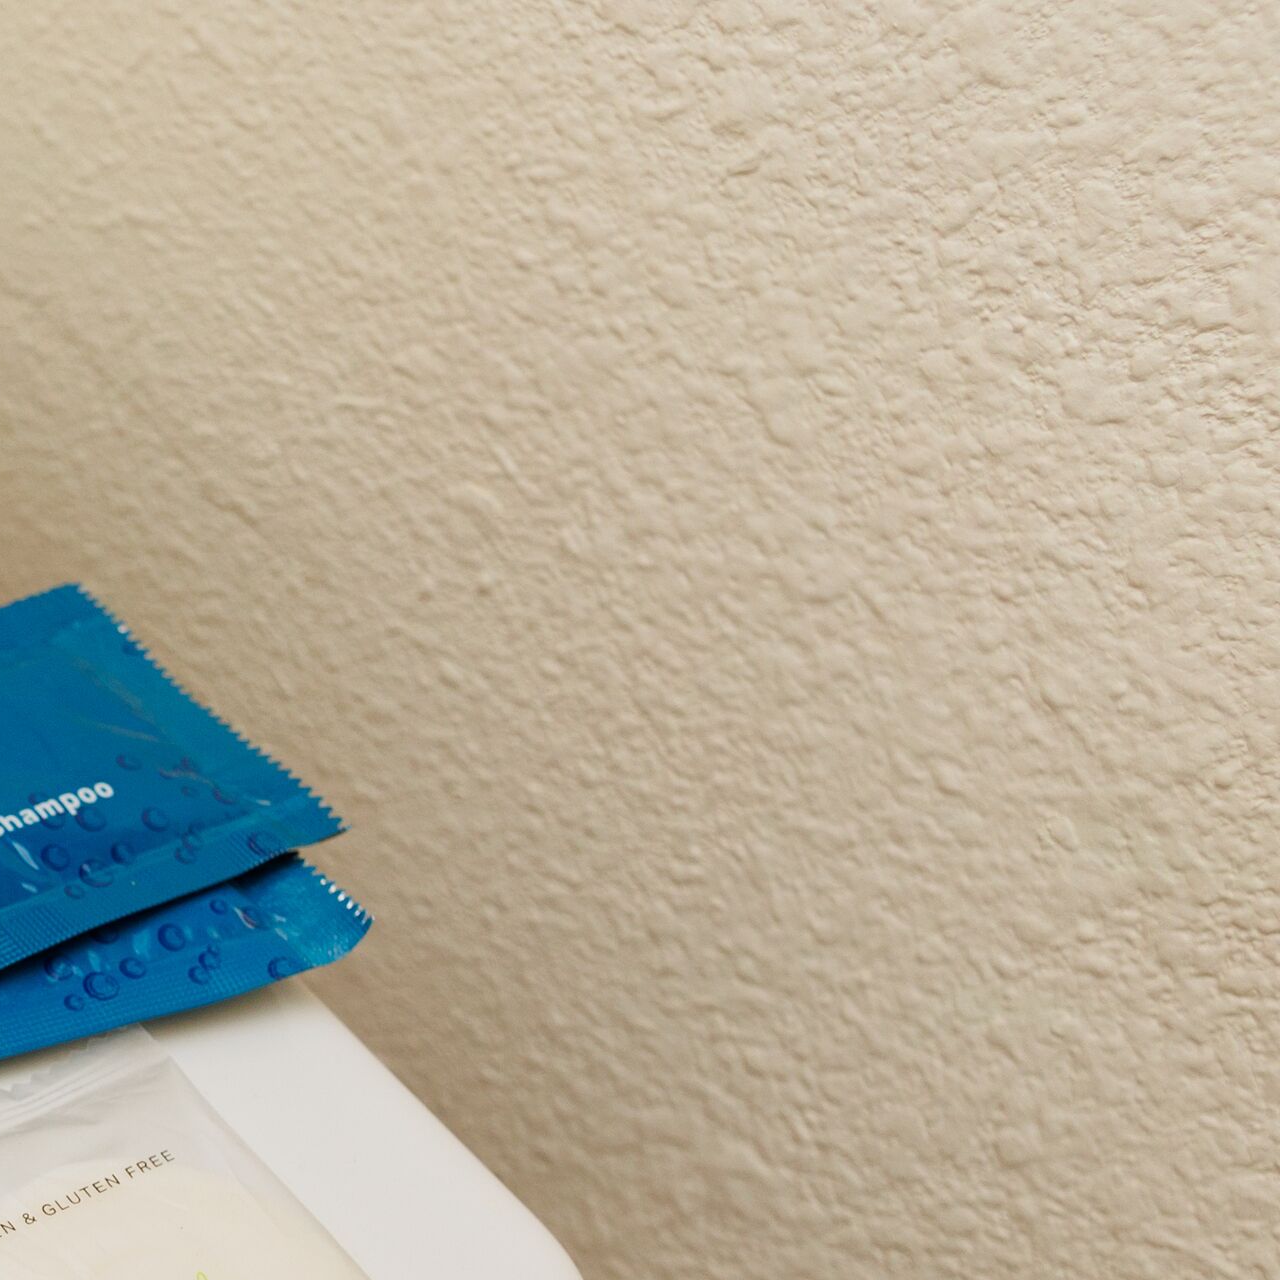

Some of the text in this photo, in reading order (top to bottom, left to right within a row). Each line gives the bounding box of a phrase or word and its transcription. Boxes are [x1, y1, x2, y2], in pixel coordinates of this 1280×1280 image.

[23, 1211, 36, 1225] &
[42, 1174, 121, 1217] GLUTEN
[125, 1150, 176, 1181] FREE
